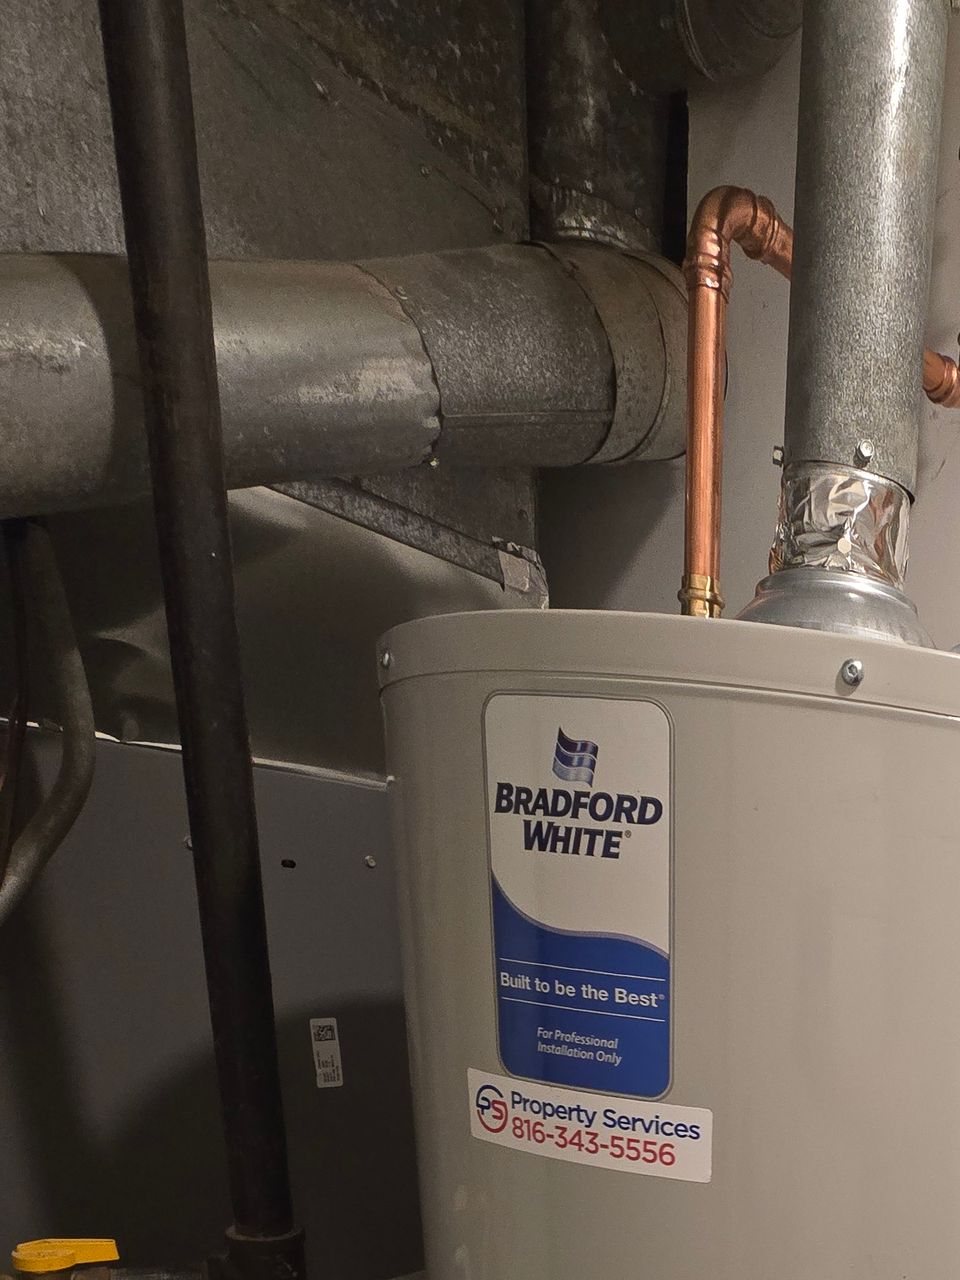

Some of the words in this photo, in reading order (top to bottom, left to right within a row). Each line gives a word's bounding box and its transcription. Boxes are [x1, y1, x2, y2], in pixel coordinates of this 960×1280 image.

[494, 782, 663, 826] BRADFORD
[500, 972, 532, 991] Built
[534, 978, 550, 993] to
[555, 980, 576, 997] be
[581, 984, 608, 1001] the
[537, 1026, 553, 1040] For
[554, 1030, 619, 1050] Professional
[538, 1042, 594, 1060] Installation
[596, 1050, 622, 1066] Only
[511, 1091, 597, 1128] Property
[602, 1108, 700, 1140] Services
[512, 1116, 676, 1166] 816-343-5556
